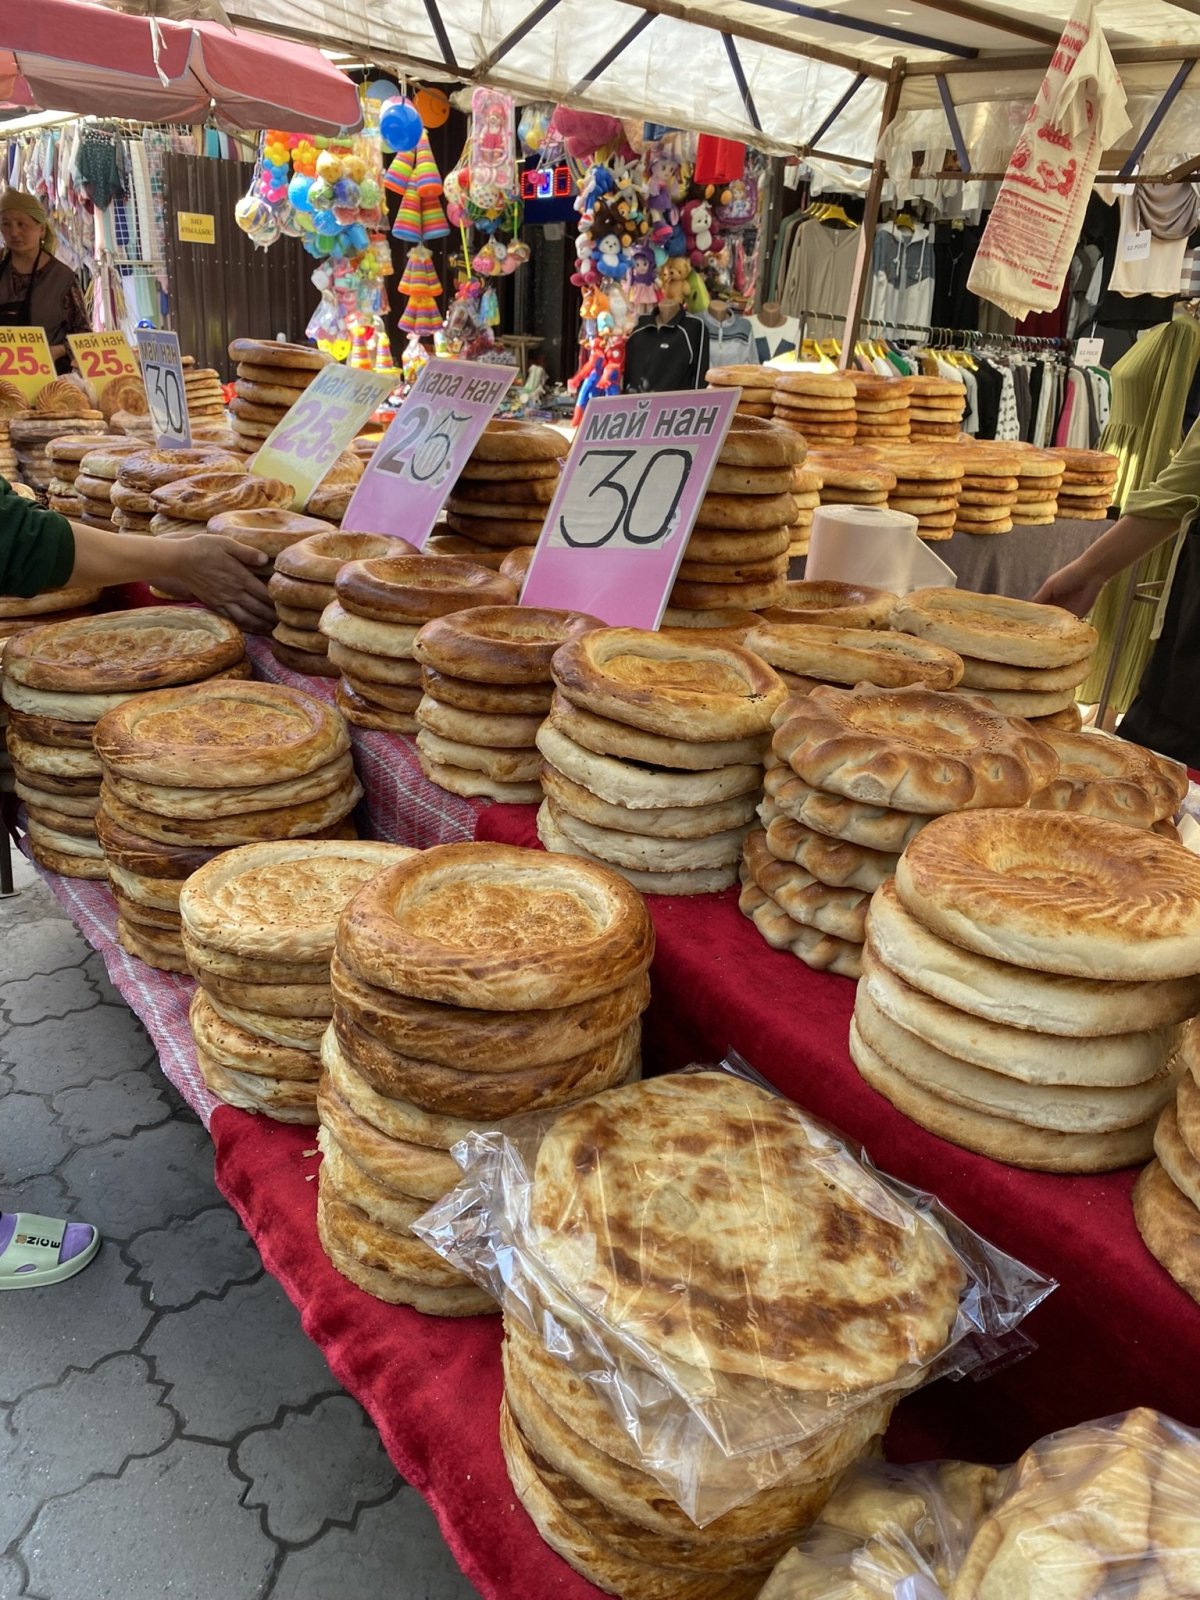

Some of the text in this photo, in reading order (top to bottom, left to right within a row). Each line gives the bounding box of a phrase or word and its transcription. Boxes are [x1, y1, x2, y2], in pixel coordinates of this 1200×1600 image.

[0, 329, 45, 344] ай нан
[74, 335, 126, 349] май нан
[141, 338, 177, 364] май нан
[81, 349, 135, 378] 25с
[145, 364, 183, 434] 30
[347, 383, 384, 406] нан
[417, 371, 504, 404] кара нан
[585, 401, 719, 441] май нан
[560, 448, 693, 548] 30
